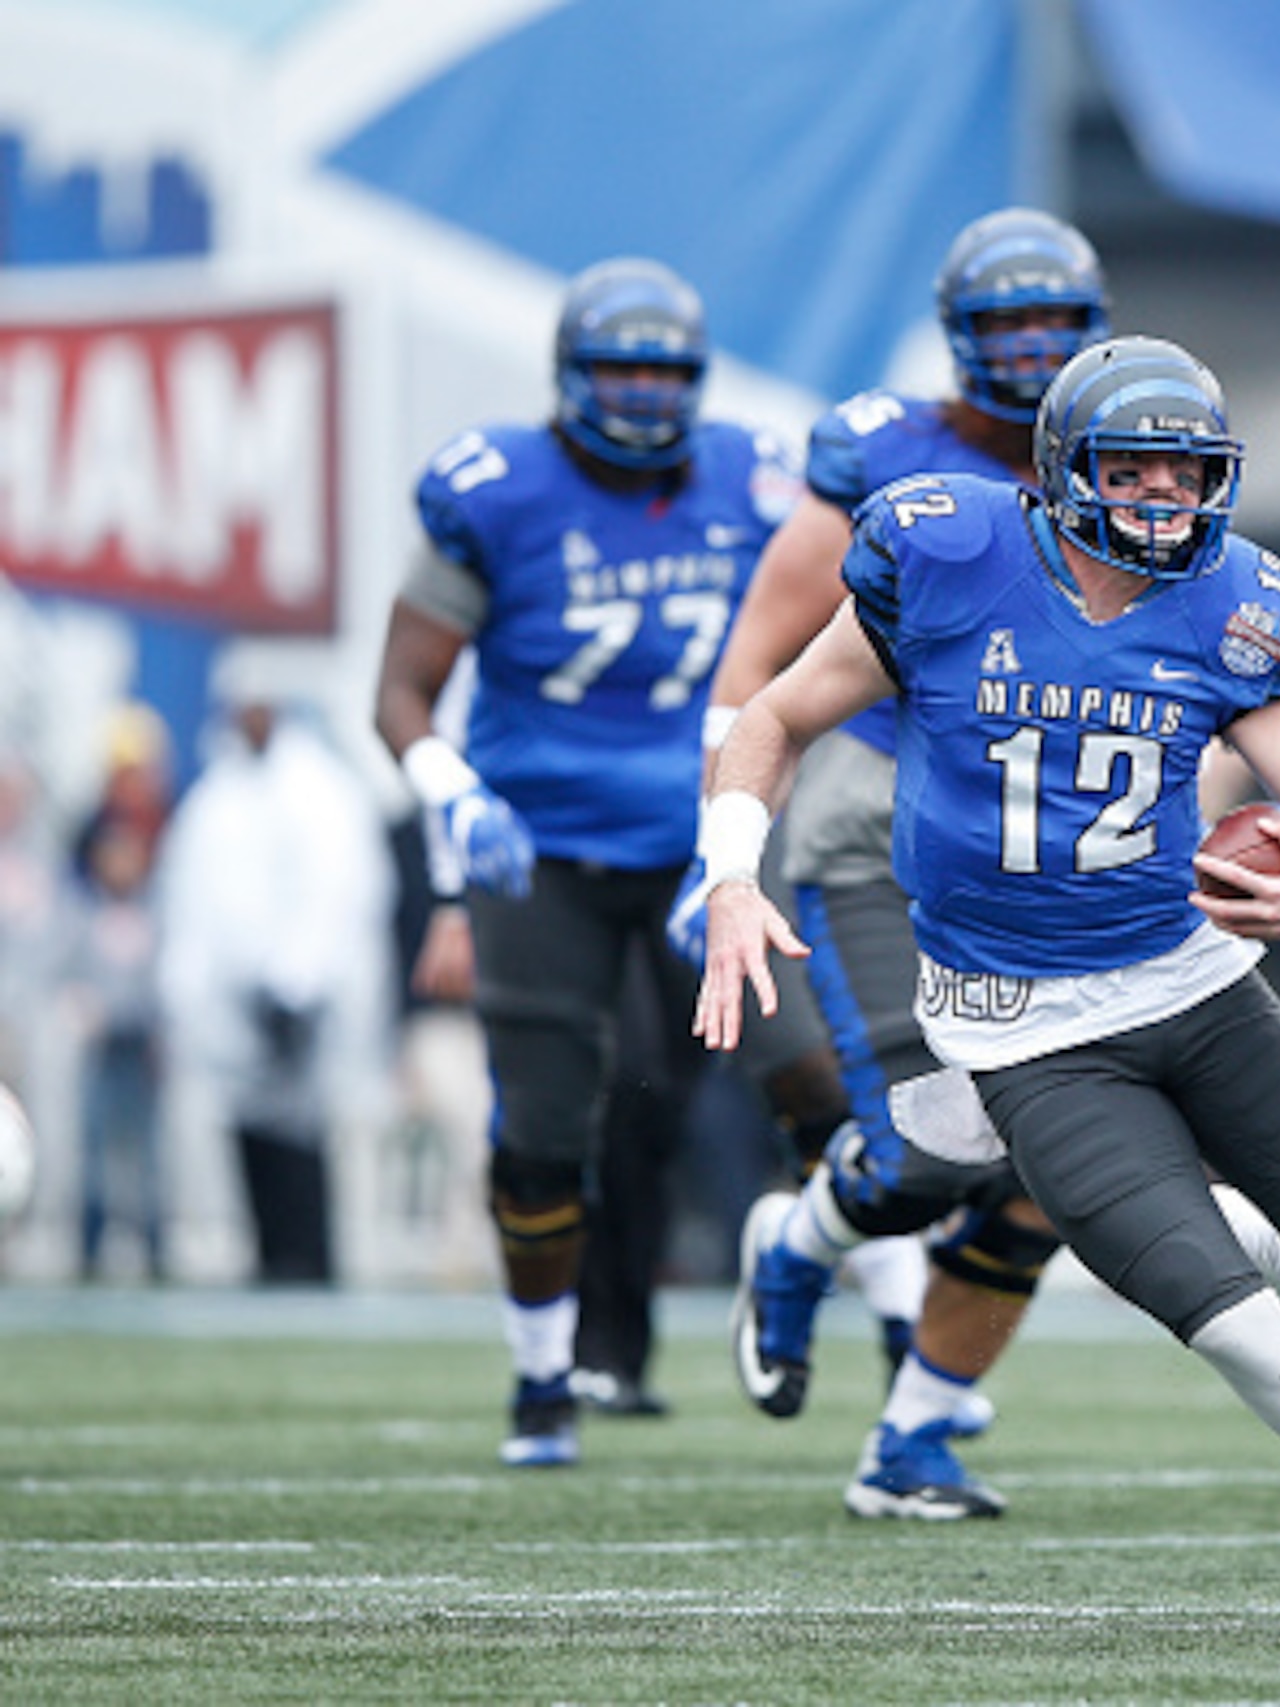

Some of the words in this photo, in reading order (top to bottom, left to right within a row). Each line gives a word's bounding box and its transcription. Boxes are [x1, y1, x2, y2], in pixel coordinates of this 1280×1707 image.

[540, 592, 732, 713] 77
[976, 678, 1185, 737] MEMPHIS
[986, 725, 1166, 874] 12
